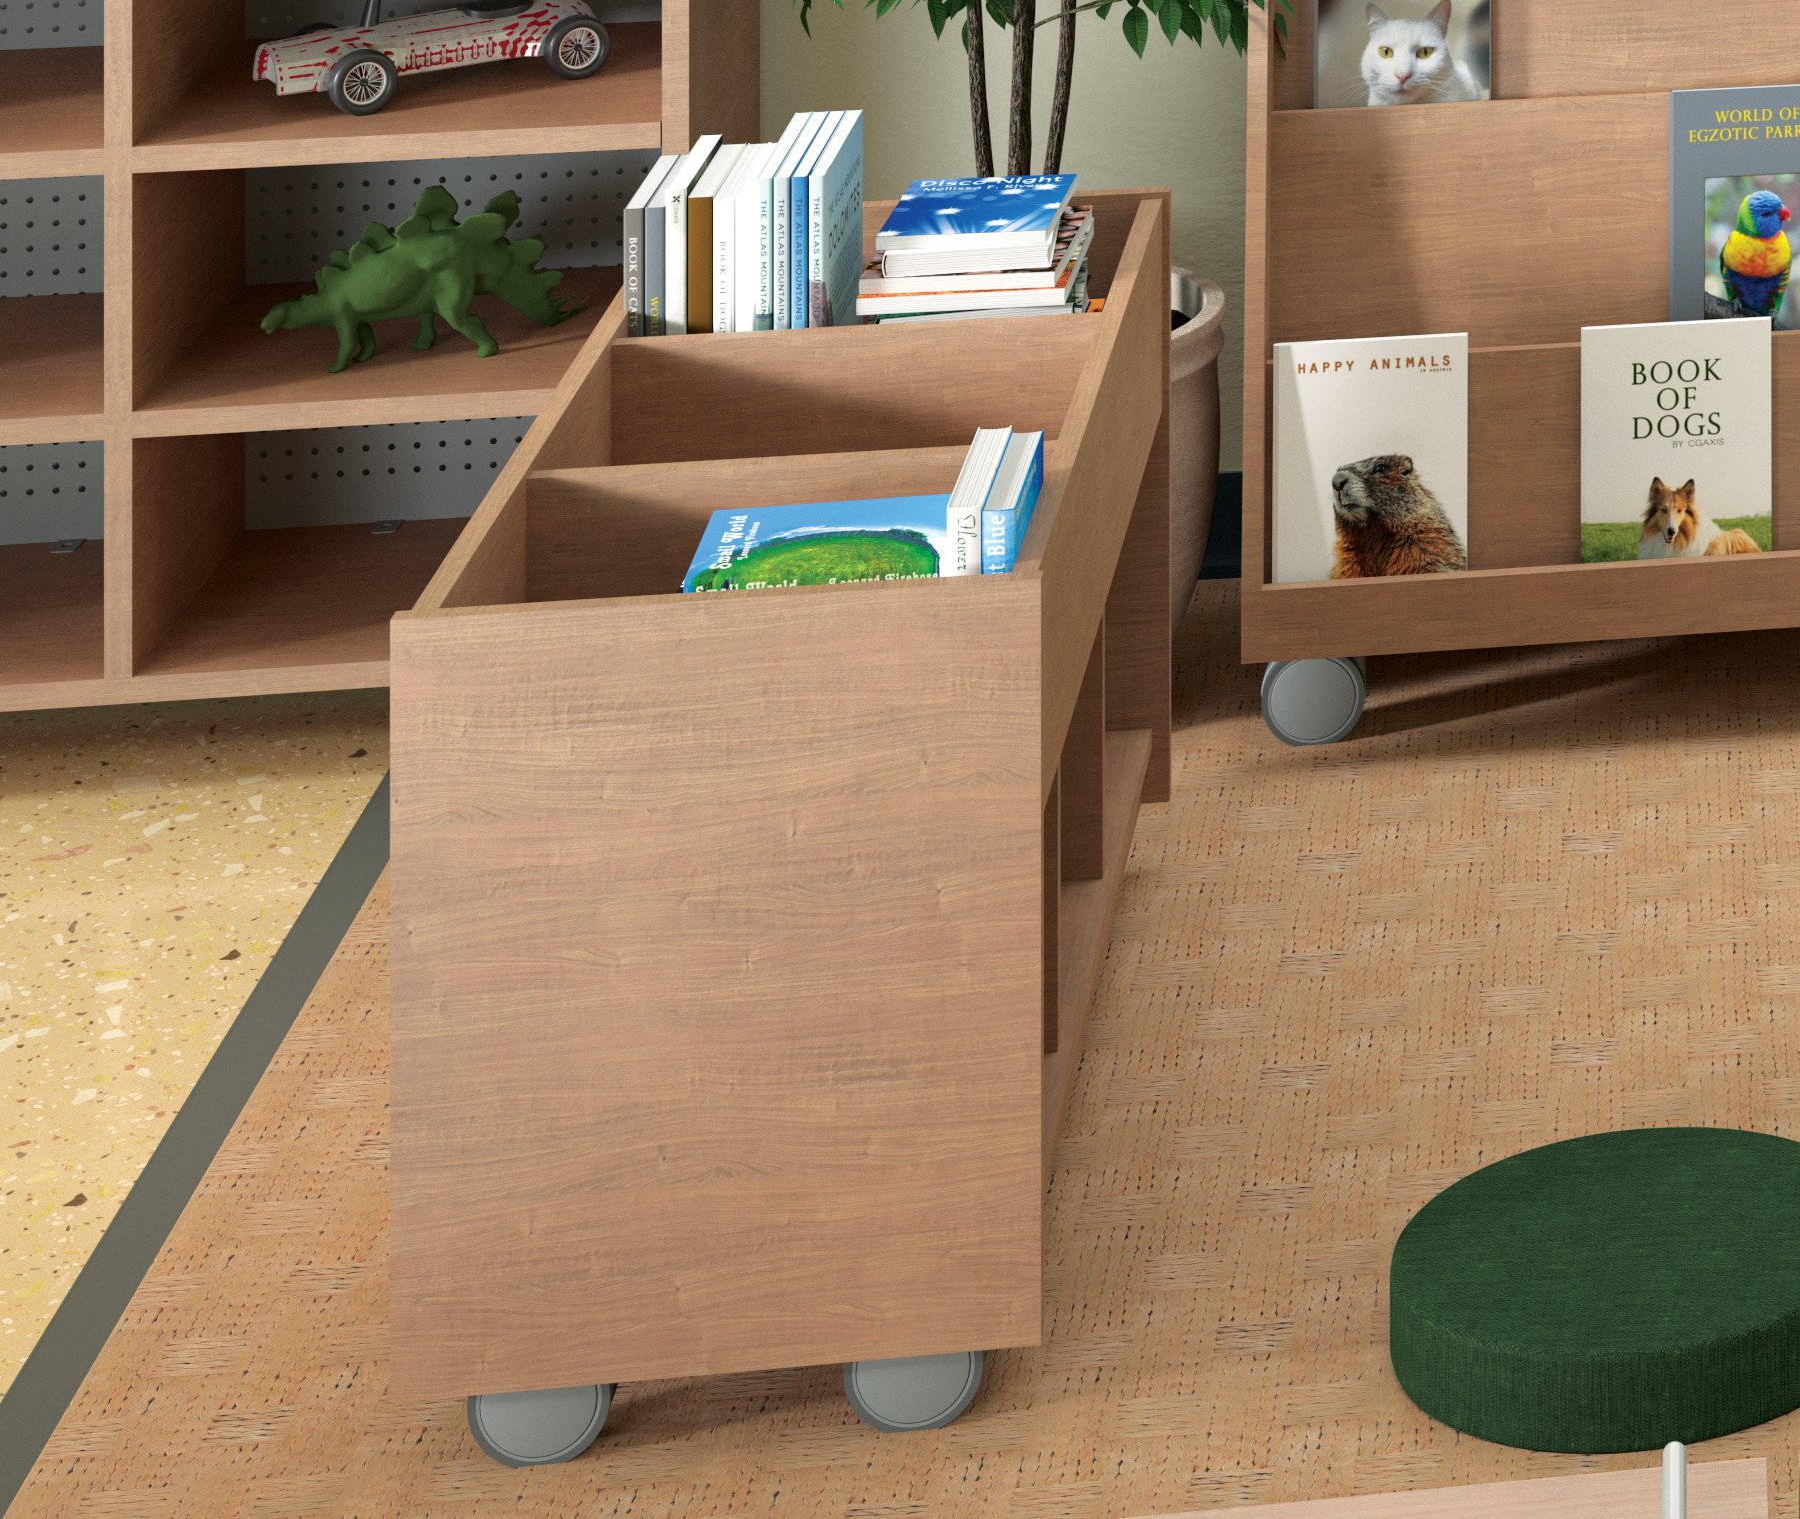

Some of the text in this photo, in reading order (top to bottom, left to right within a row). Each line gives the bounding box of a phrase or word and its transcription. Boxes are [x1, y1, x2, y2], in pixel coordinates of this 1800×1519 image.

[1715, 106, 1800, 123] WORLD OF
[1688, 126, 1760, 143] EGZOTIC
[998, 176, 1064, 185] Night
[629, 237, 638, 328] BOOK OF CATS
[1298, 354, 1451, 374] HAPPY ANIMALS
[1632, 358, 1722, 386] BOOK
[1656, 386, 1696, 411] OF
[1632, 412, 1722, 440] DOGS
[1672, 438, 1724, 448] BY CGAXIS
[709, 514, 748, 570] Small World
[984, 515, 1006, 557] Blue
